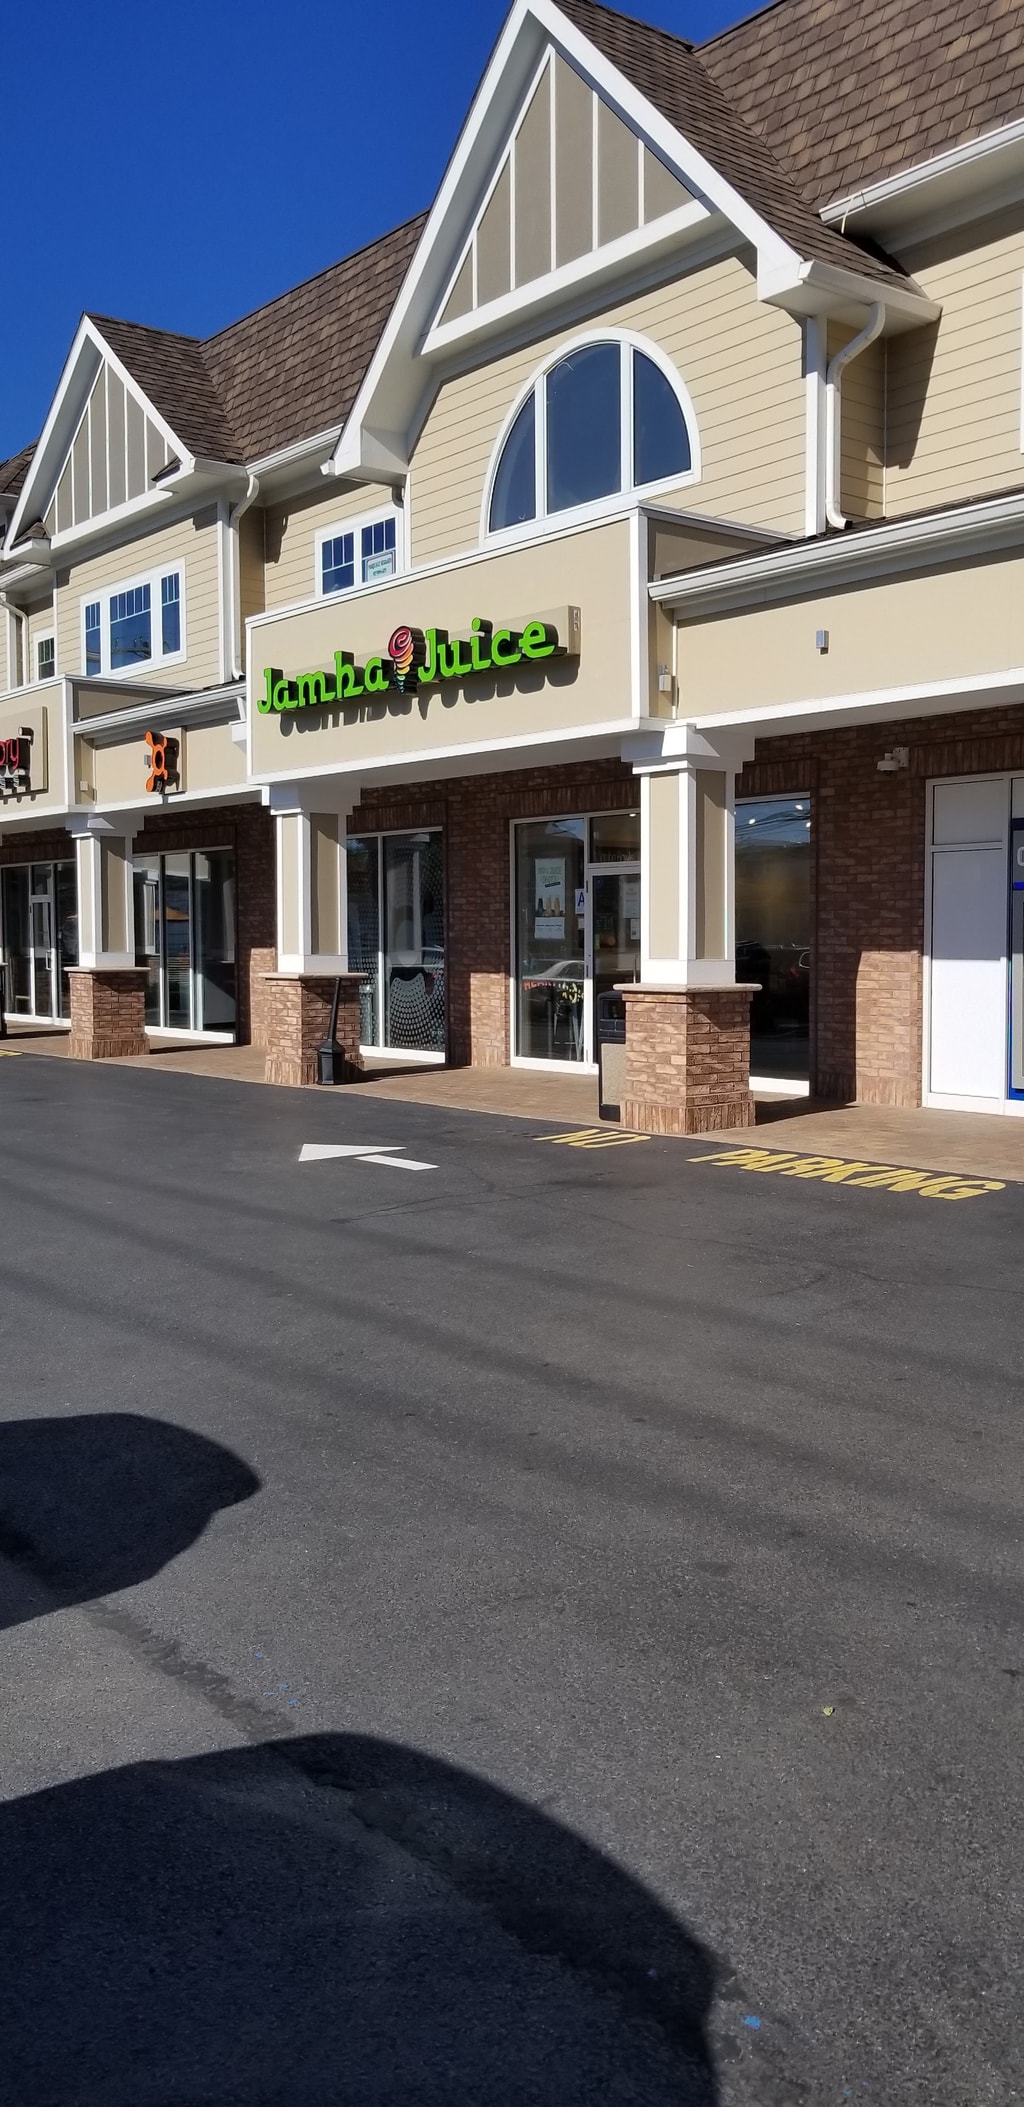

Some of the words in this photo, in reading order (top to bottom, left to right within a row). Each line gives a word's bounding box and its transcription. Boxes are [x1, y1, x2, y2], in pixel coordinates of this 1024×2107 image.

[257, 650, 390, 714] Jamba
[417, 617, 555, 683] Juice
[577, 891, 585, 907] A
[534, 1129, 652, 1148] NO
[686, 1149, 1006, 1200] PARKING
